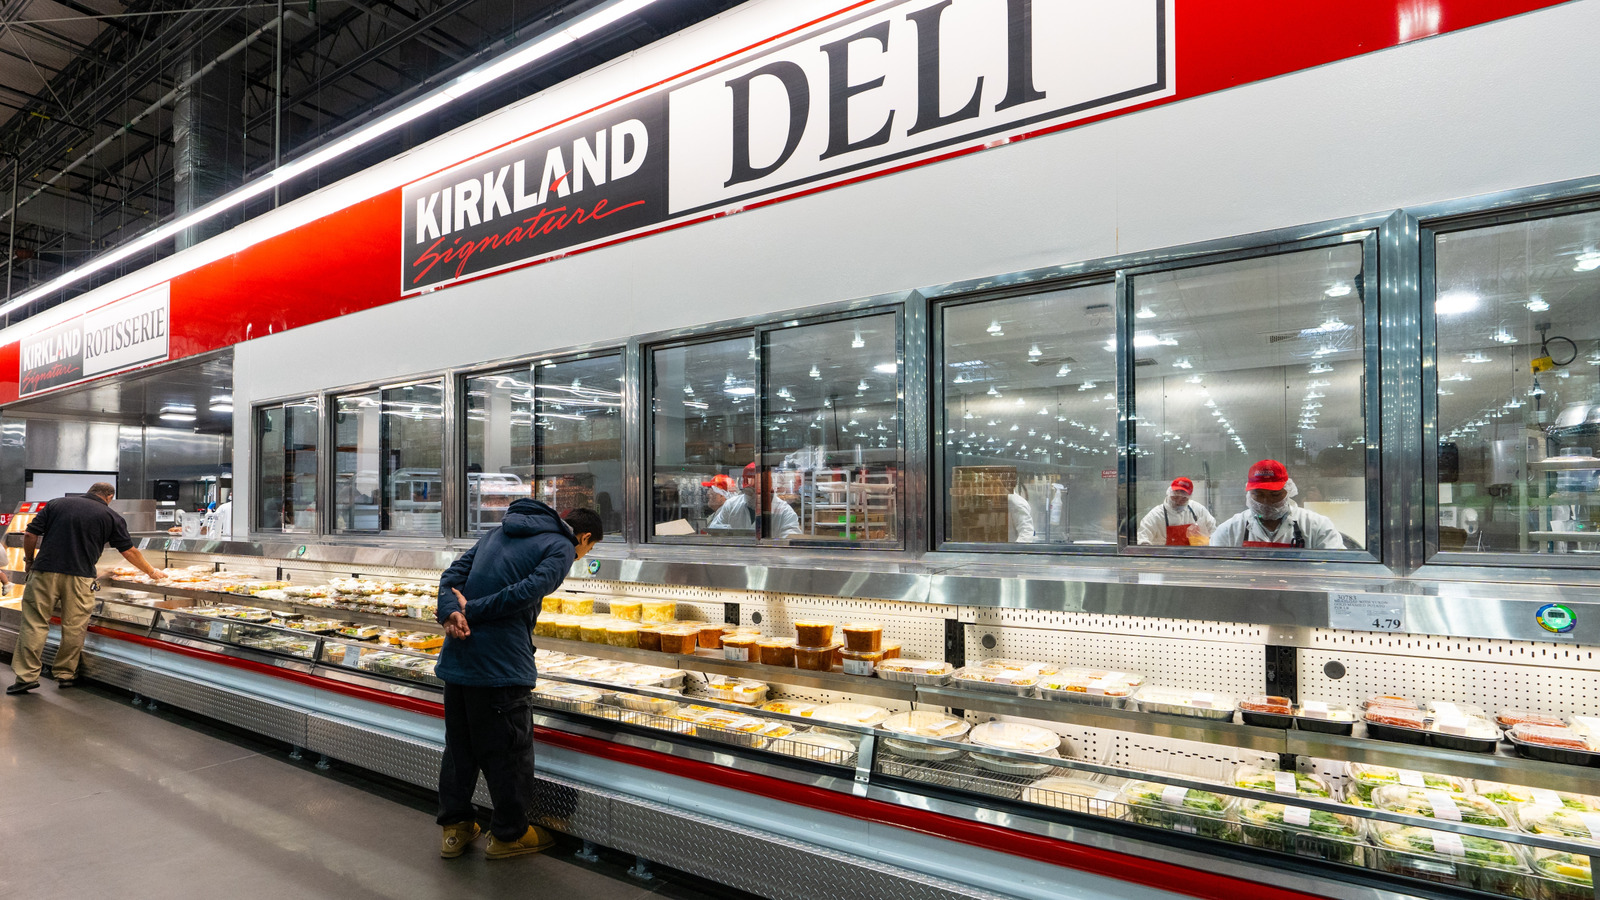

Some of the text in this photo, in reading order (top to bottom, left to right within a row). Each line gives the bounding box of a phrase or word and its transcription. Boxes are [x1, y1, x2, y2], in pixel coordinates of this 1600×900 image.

[723, 0, 1047, 189] DELI
[416, 118, 649, 245] KIRKLAND
[413, 198, 646, 284] Signature
[23, 328, 81, 371] KIRKLAND
[85, 306, 165, 360] ROTISSERIE
[22, 363, 80, 393] Signature
[1372, 618, 1401, 629] 4.79
